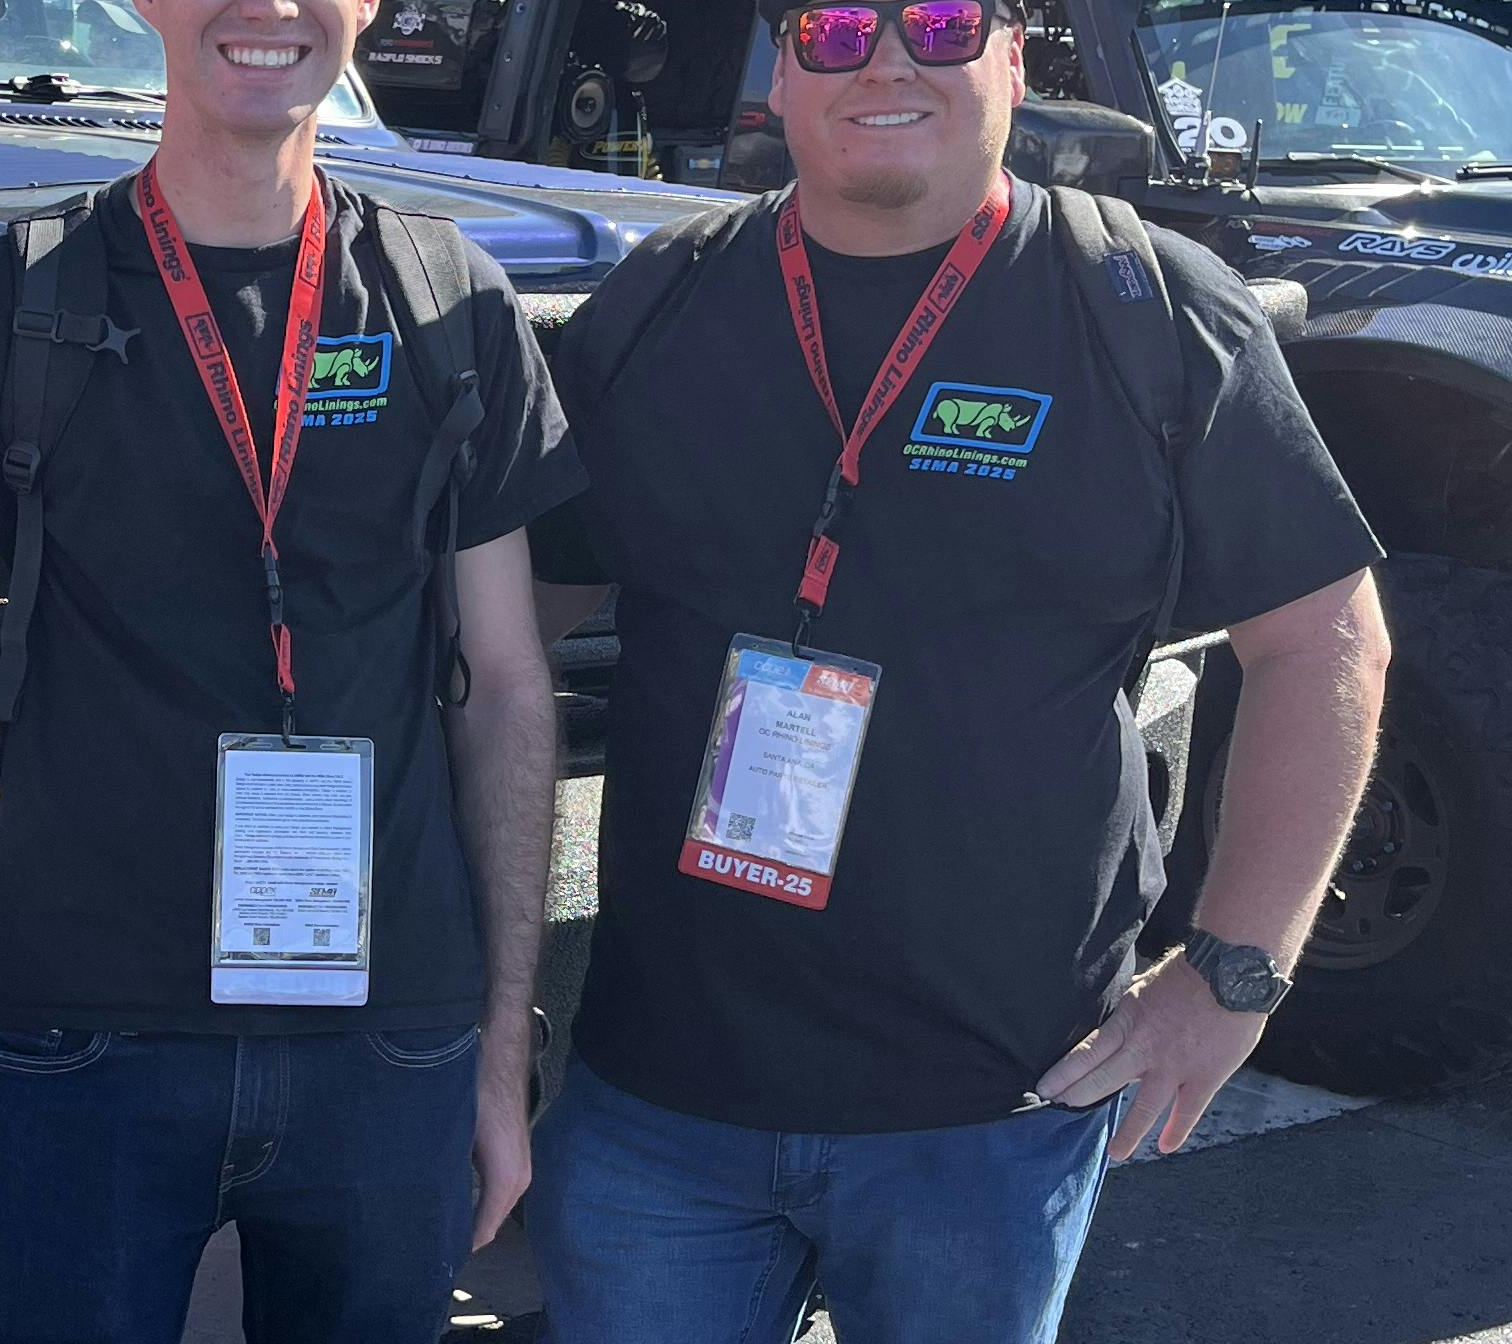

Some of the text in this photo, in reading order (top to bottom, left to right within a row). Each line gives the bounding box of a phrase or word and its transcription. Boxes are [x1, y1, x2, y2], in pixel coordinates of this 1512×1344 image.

[150, 208, 186, 282] Linings
[791, 274, 816, 342] Linings
[896, 306, 937, 365] Rhino
[206, 361, 237, 425] Rhino
[300, 410, 378, 427] MA 2025
[903, 444, 1028, 468] OCRhinoLinings.com
[909, 458, 1017, 480] SEMA 2025
[786, 709, 812, 722] ALAN
[775, 719, 817, 737] MARTELL
[748, 765, 768, 775] AUTO
[698, 849, 813, 897] BUYER-25
